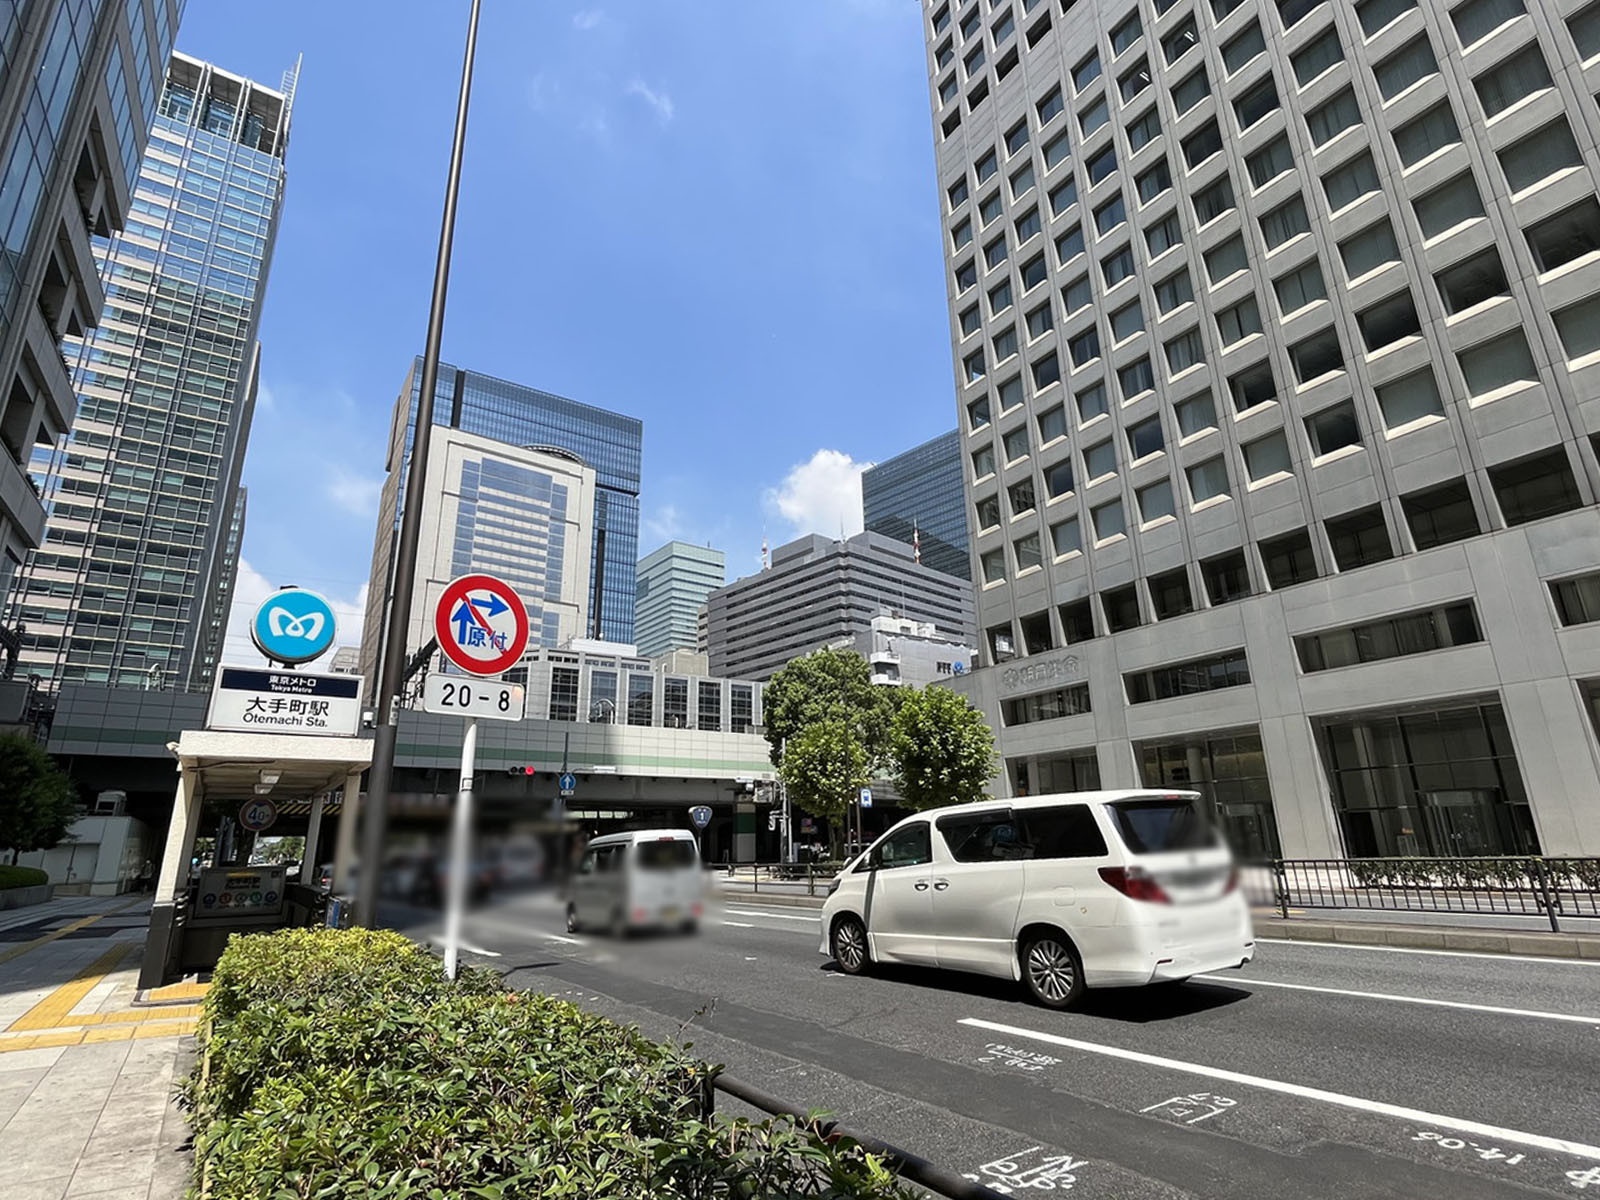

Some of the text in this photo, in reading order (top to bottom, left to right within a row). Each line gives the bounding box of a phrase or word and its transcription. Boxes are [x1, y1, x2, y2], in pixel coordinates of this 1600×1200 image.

[467, 625, 508, 652] 原付
[269, 675, 317, 687] 東京メトロ
[271, 684, 313, 694] Tokyo Metro
[246, 696, 330, 717] 大手町駅
[243, 712, 328, 728] Otemachi Sta.
